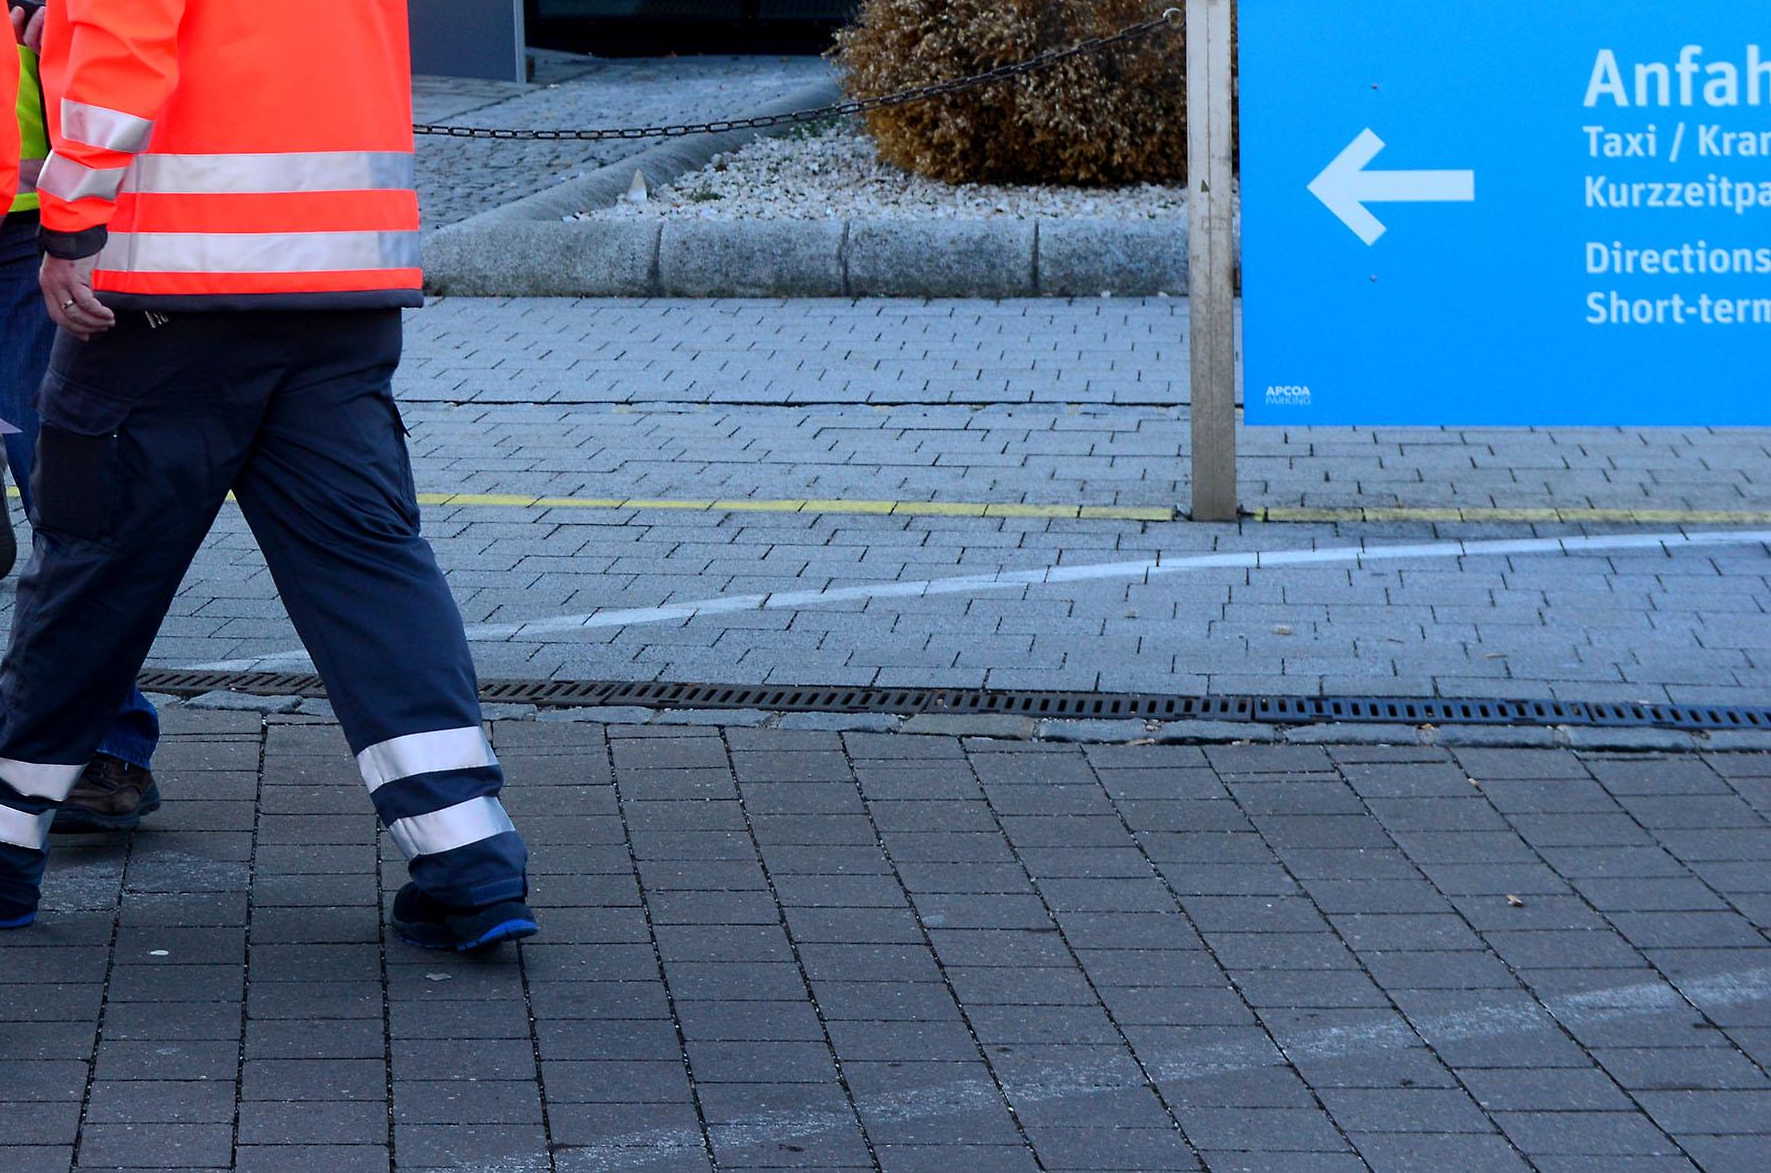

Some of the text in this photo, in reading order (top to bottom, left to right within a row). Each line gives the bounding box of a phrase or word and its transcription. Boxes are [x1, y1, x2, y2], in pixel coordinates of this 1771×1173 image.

[1583, 43, 1771, 107] Anfah
[1582, 123, 1657, 157] Taxi
[1586, 239, 1771, 274] Directions
[1265, 385, 1311, 396] APCOA
[1265, 395, 1312, 405] PARKING
